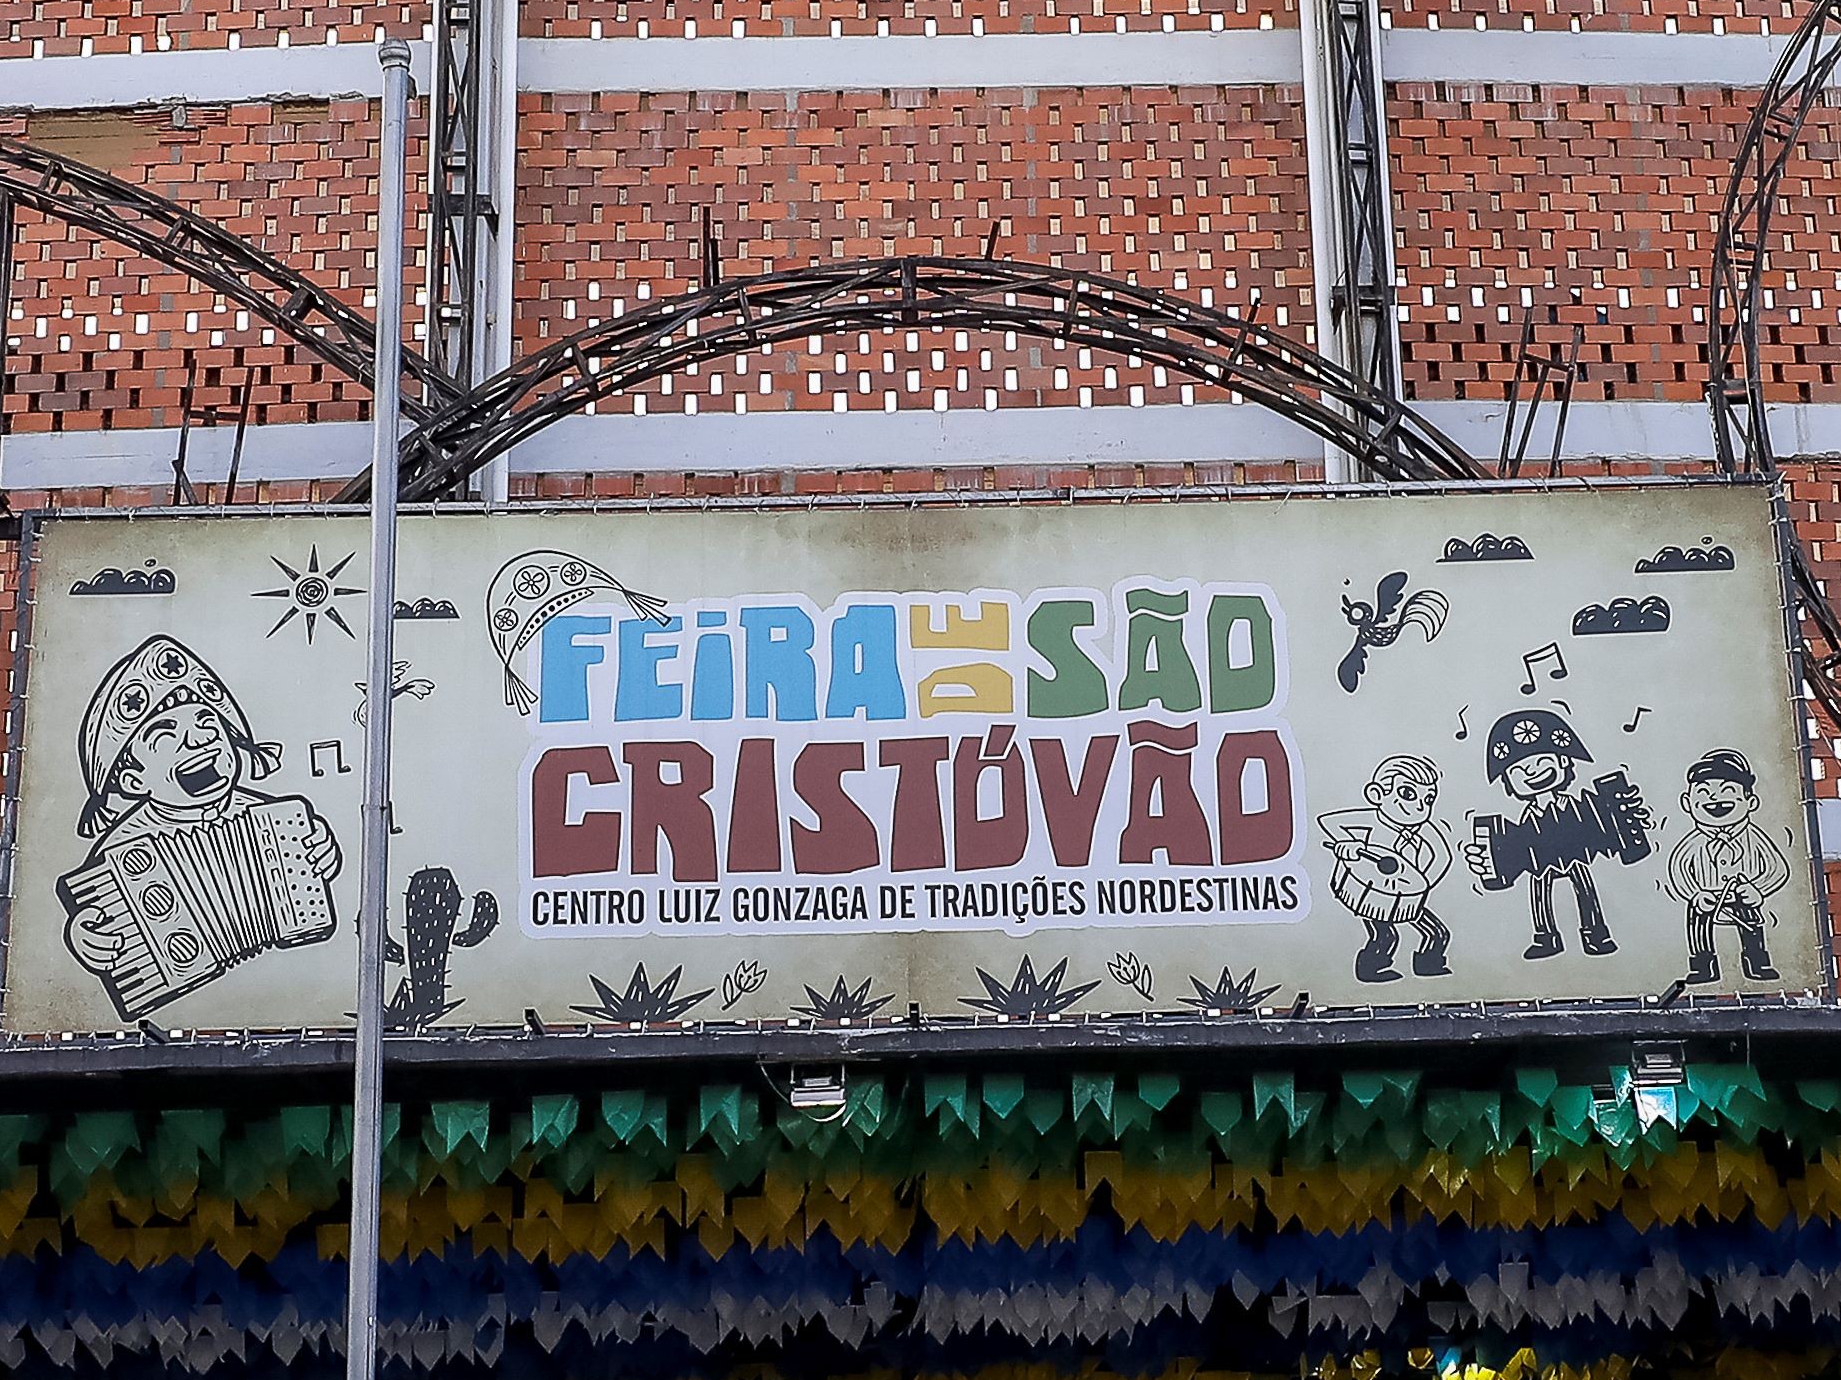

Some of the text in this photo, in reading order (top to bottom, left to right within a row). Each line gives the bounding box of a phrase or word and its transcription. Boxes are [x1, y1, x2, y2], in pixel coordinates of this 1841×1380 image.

[909, 599, 1014, 718] DE
[1026, 586, 1275, 718] SÃO
[531, 721, 1294, 882] CRISTÓVÃO
[530, 874, 1299, 926] CENTRO LUIZ GONZAGA DE TRADIÇÕES NORDESTINAS
